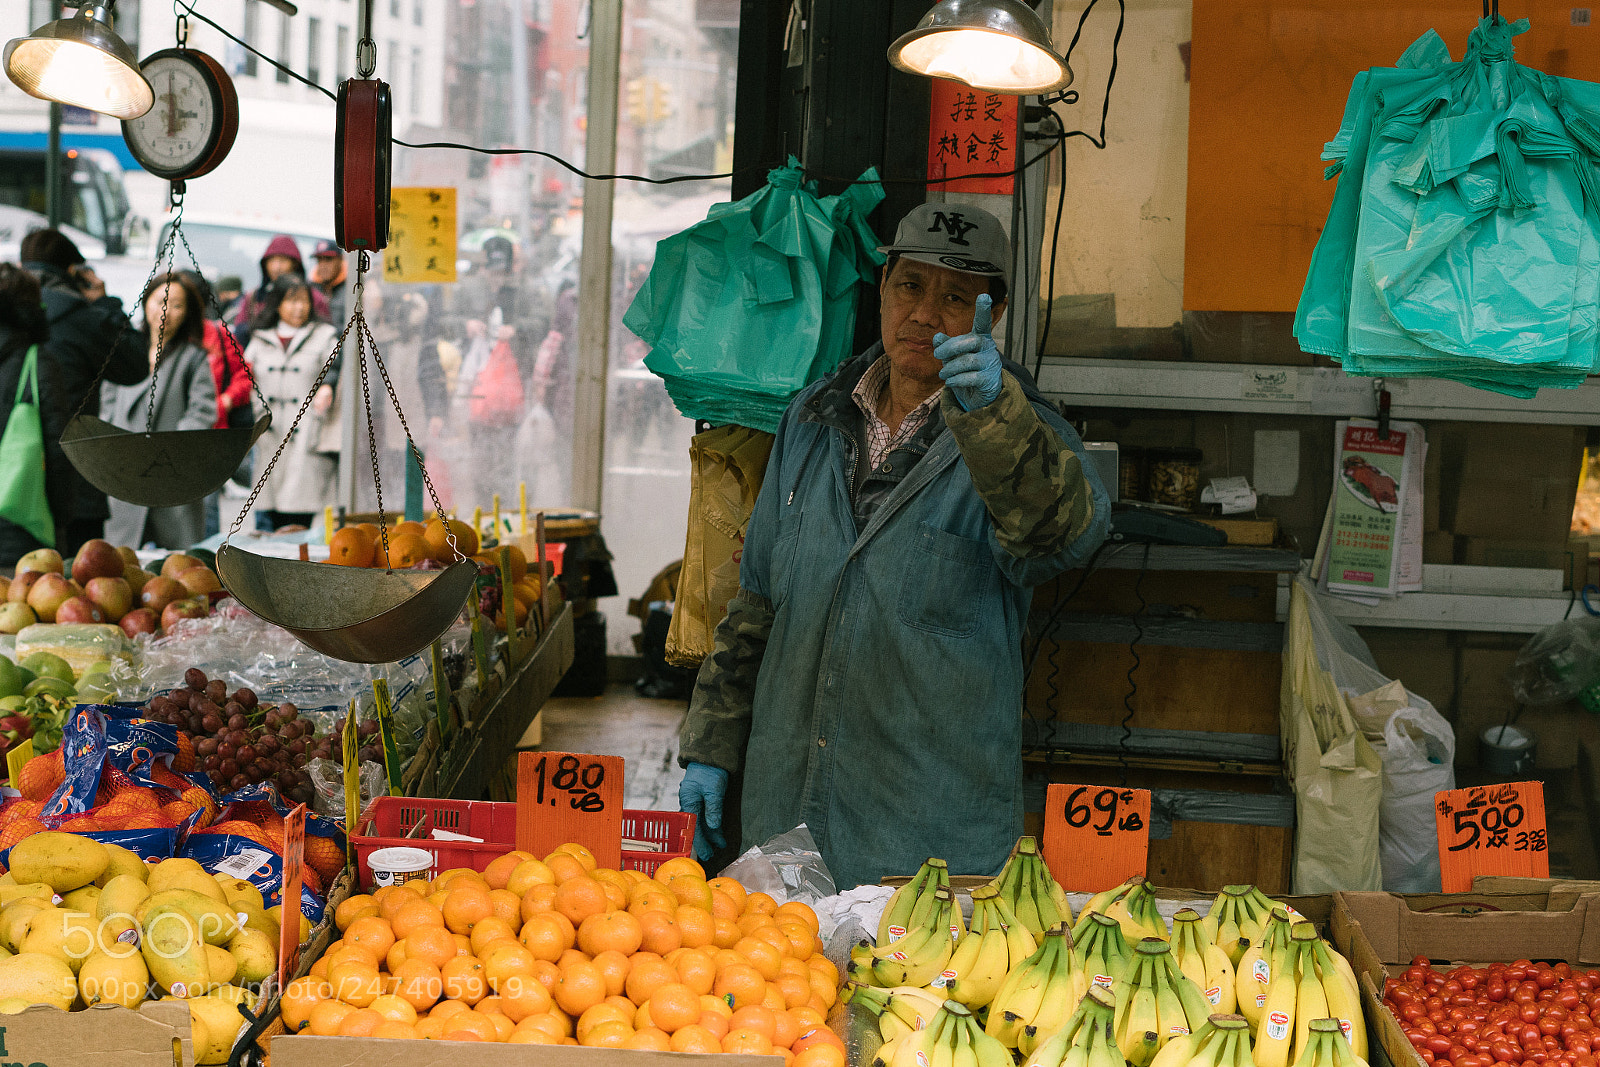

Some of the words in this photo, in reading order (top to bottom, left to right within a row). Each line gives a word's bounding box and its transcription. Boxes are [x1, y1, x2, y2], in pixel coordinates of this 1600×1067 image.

[950, 92, 1003, 123] 接受
[927, 211, 979, 246] NY
[535, 756, 604, 807] 1.80
